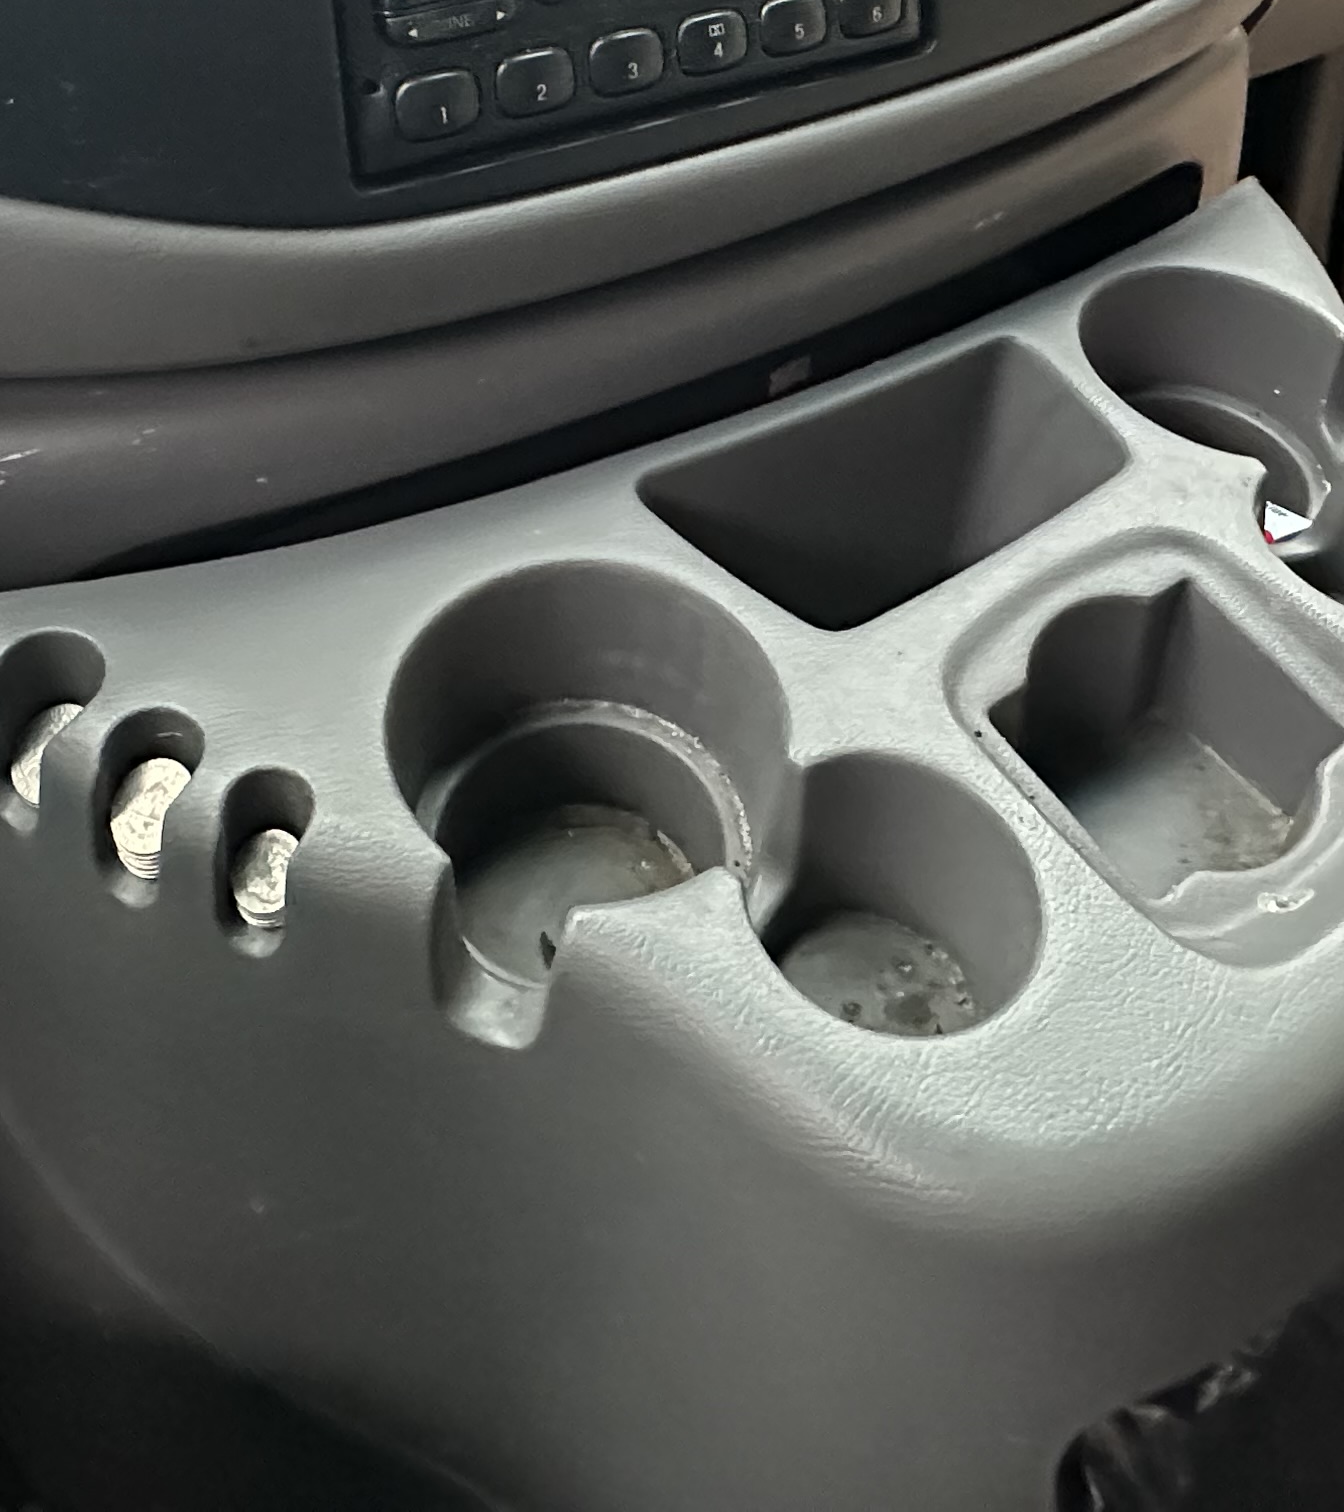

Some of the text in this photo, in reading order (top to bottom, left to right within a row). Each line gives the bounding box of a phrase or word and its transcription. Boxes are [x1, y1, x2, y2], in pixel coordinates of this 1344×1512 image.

[872, 6, 883, 23] 6
[794, 23, 805, 40] 5
[713, 42, 724, 59] 4
[627, 62, 639, 79] 3
[536, 84, 547, 101] 2
[440, 106, 448, 124] 1
